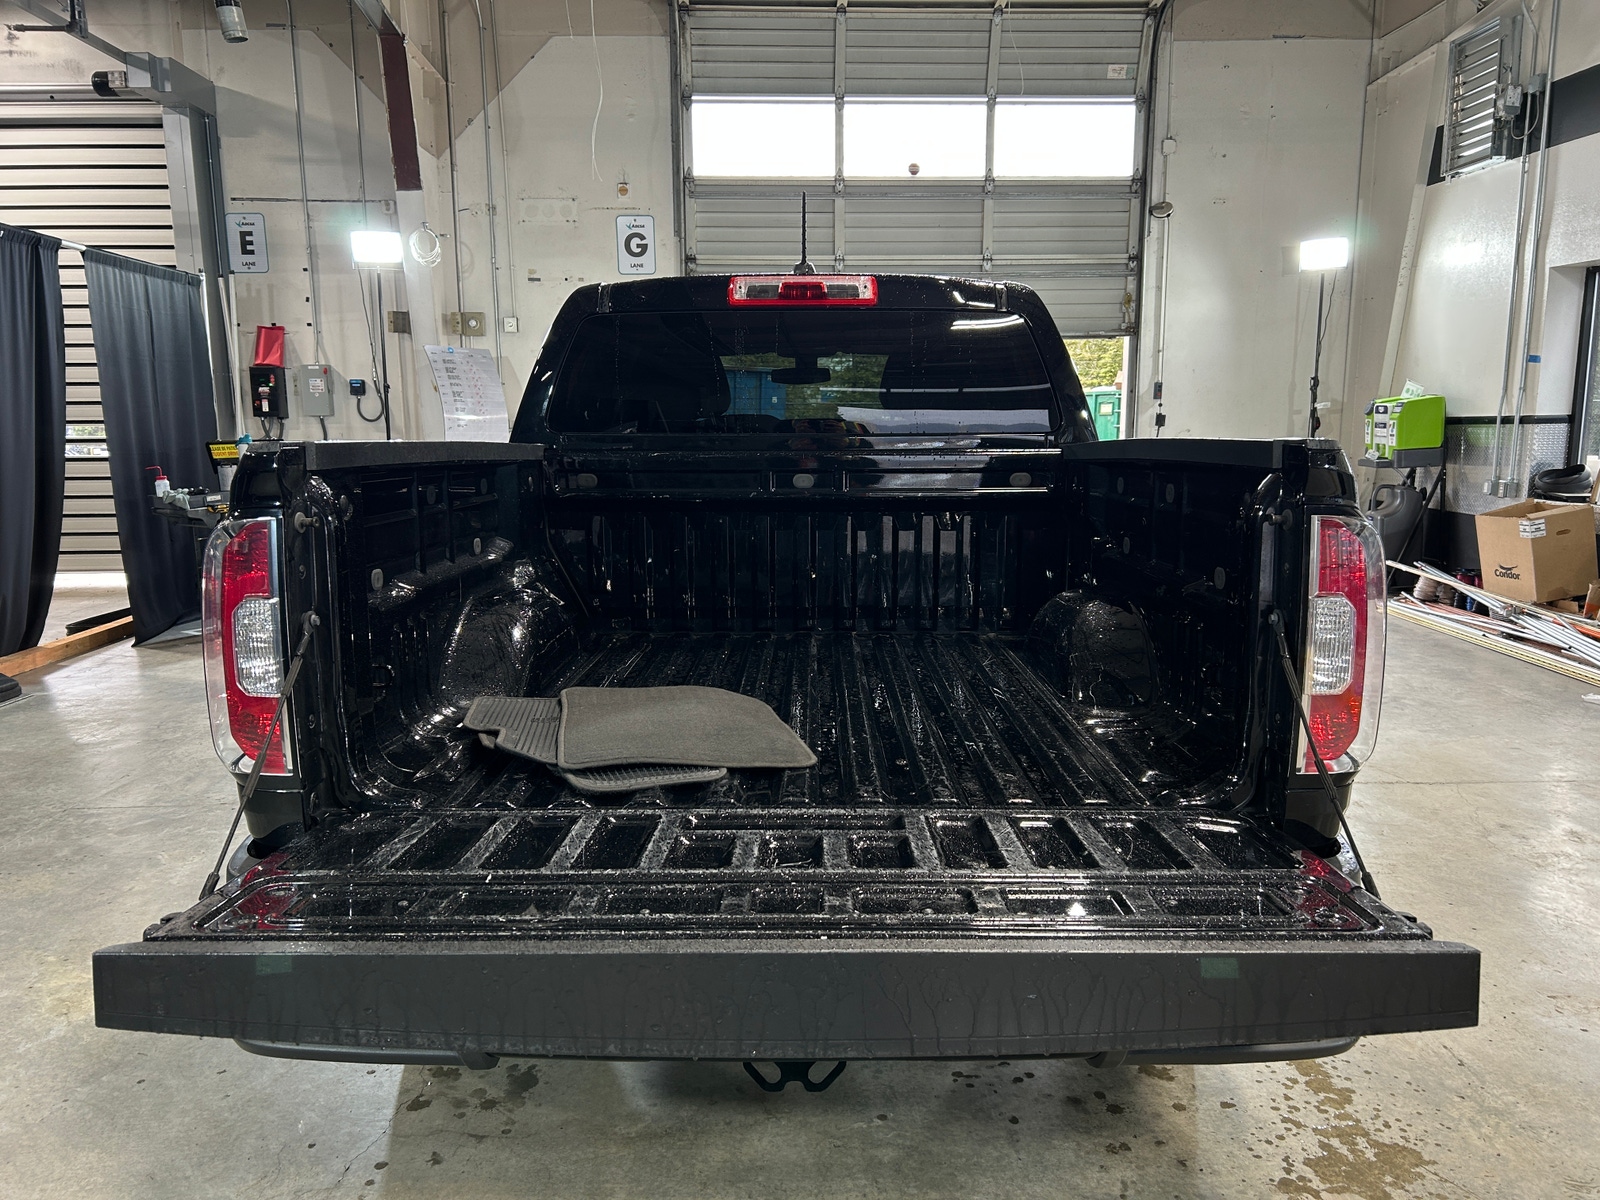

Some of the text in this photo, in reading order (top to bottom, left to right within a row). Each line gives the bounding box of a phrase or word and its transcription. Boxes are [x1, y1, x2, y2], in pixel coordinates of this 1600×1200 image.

[239, 231, 255, 255] E
[624, 232, 648, 257] G
[1494, 569, 1521, 580] Condor
